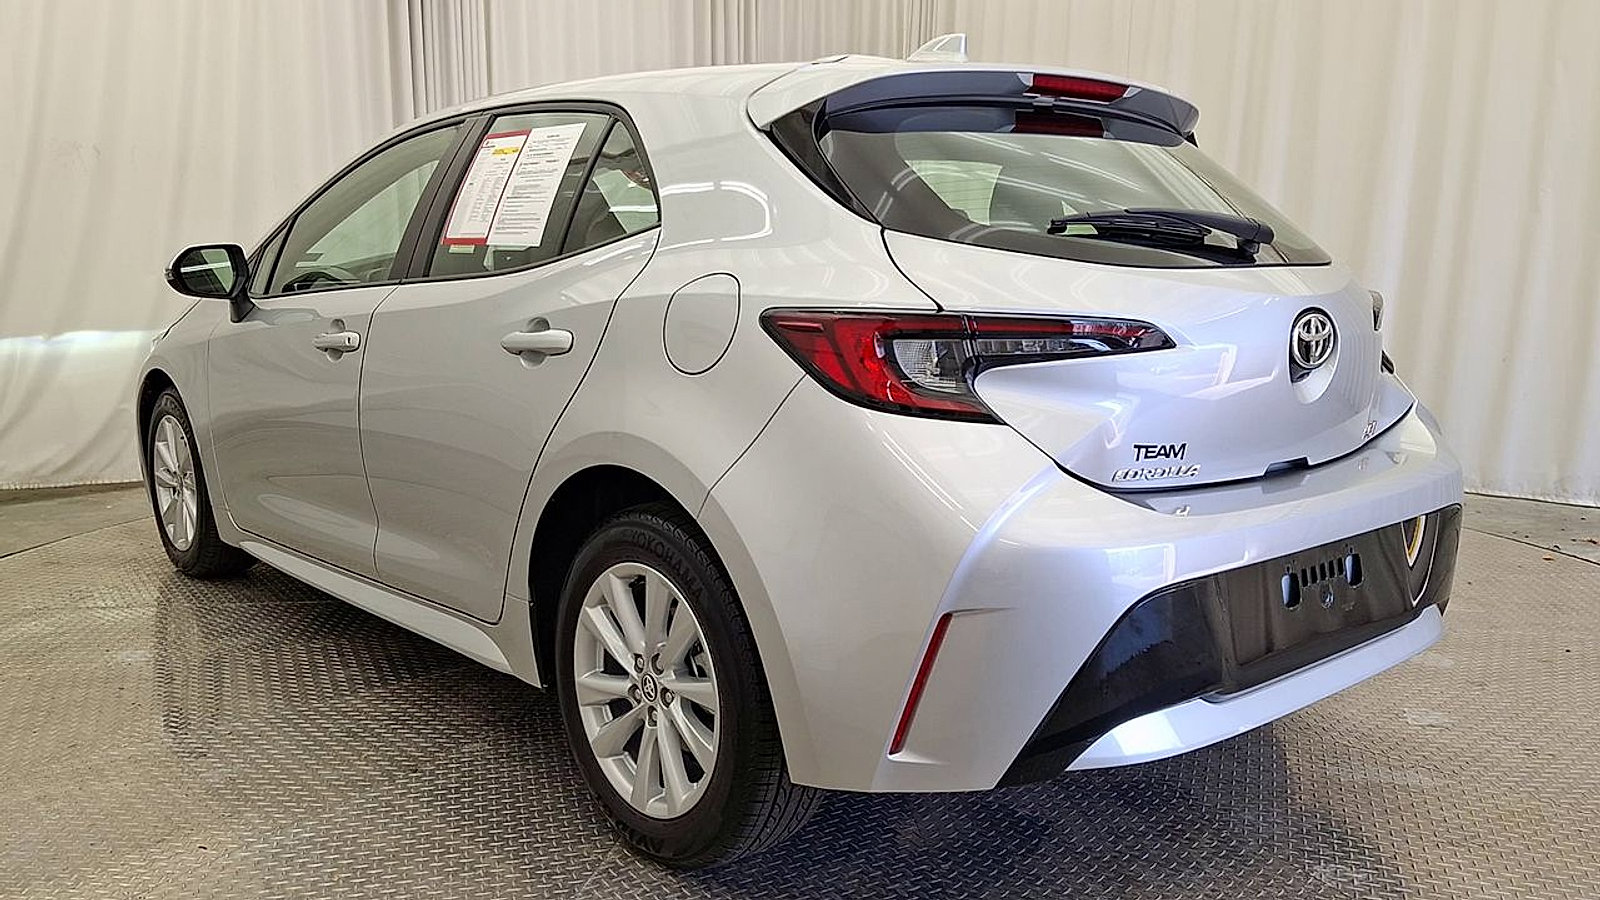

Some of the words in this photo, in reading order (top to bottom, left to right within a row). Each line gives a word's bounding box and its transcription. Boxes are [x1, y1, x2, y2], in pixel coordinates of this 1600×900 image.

[1133, 442, 1187, 461] TEAM
[1111, 465, 1200, 482] COROLLA
[631, 530, 704, 599] YOKOHAMA
